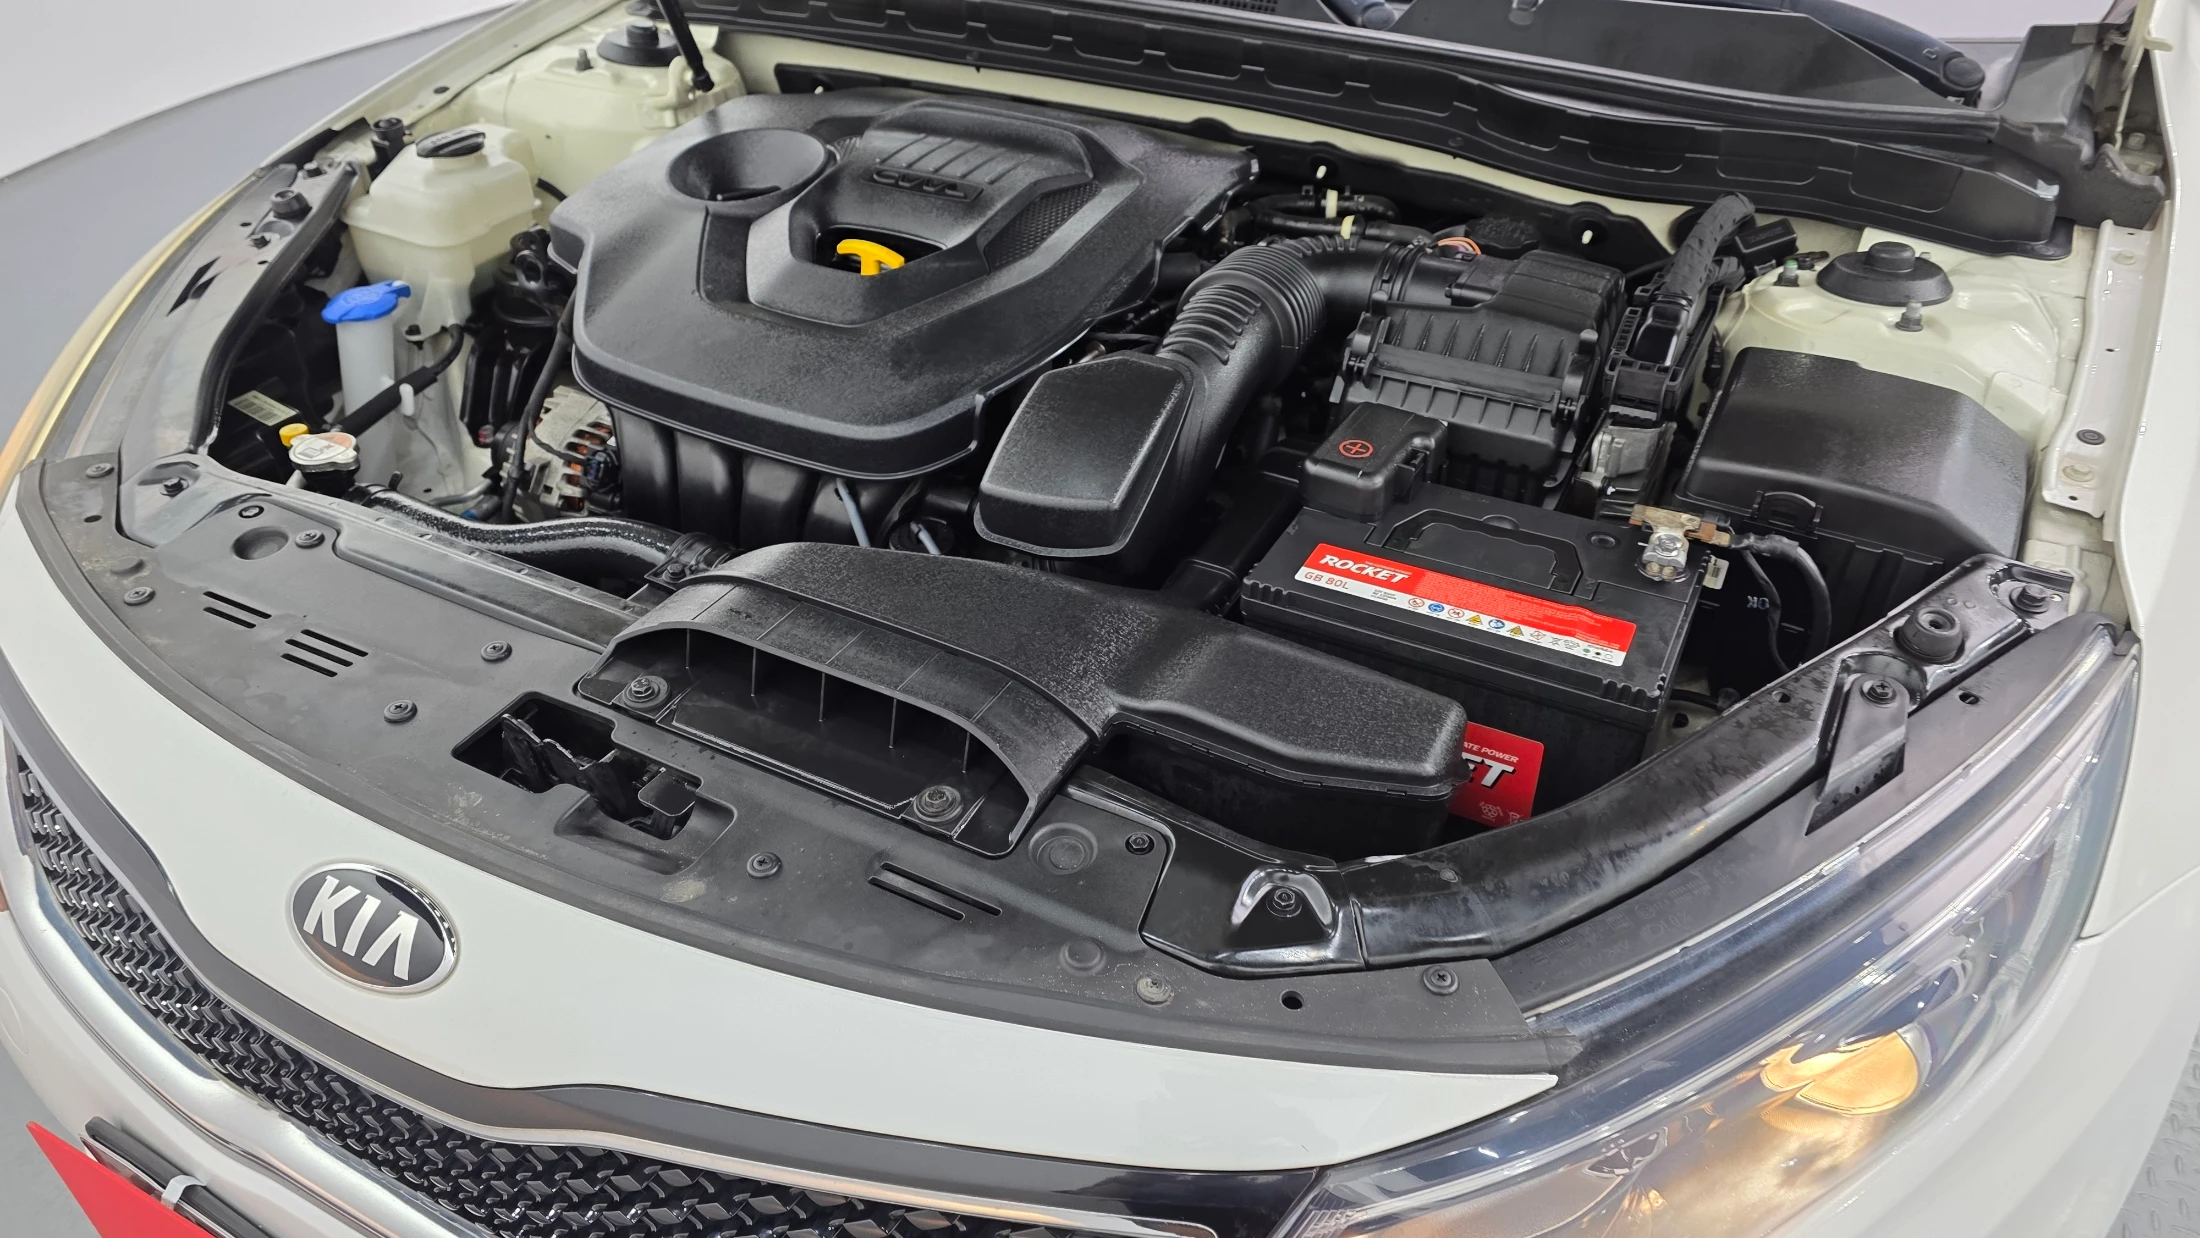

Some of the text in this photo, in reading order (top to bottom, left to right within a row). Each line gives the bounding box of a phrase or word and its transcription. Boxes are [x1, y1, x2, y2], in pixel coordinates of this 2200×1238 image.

[1304, 571, 1349, 590] GB 80L
[1319, 554, 1410, 584] ROCKET
[1481, 747, 1520, 763] POWER
[303, 874, 420, 982] KIA
